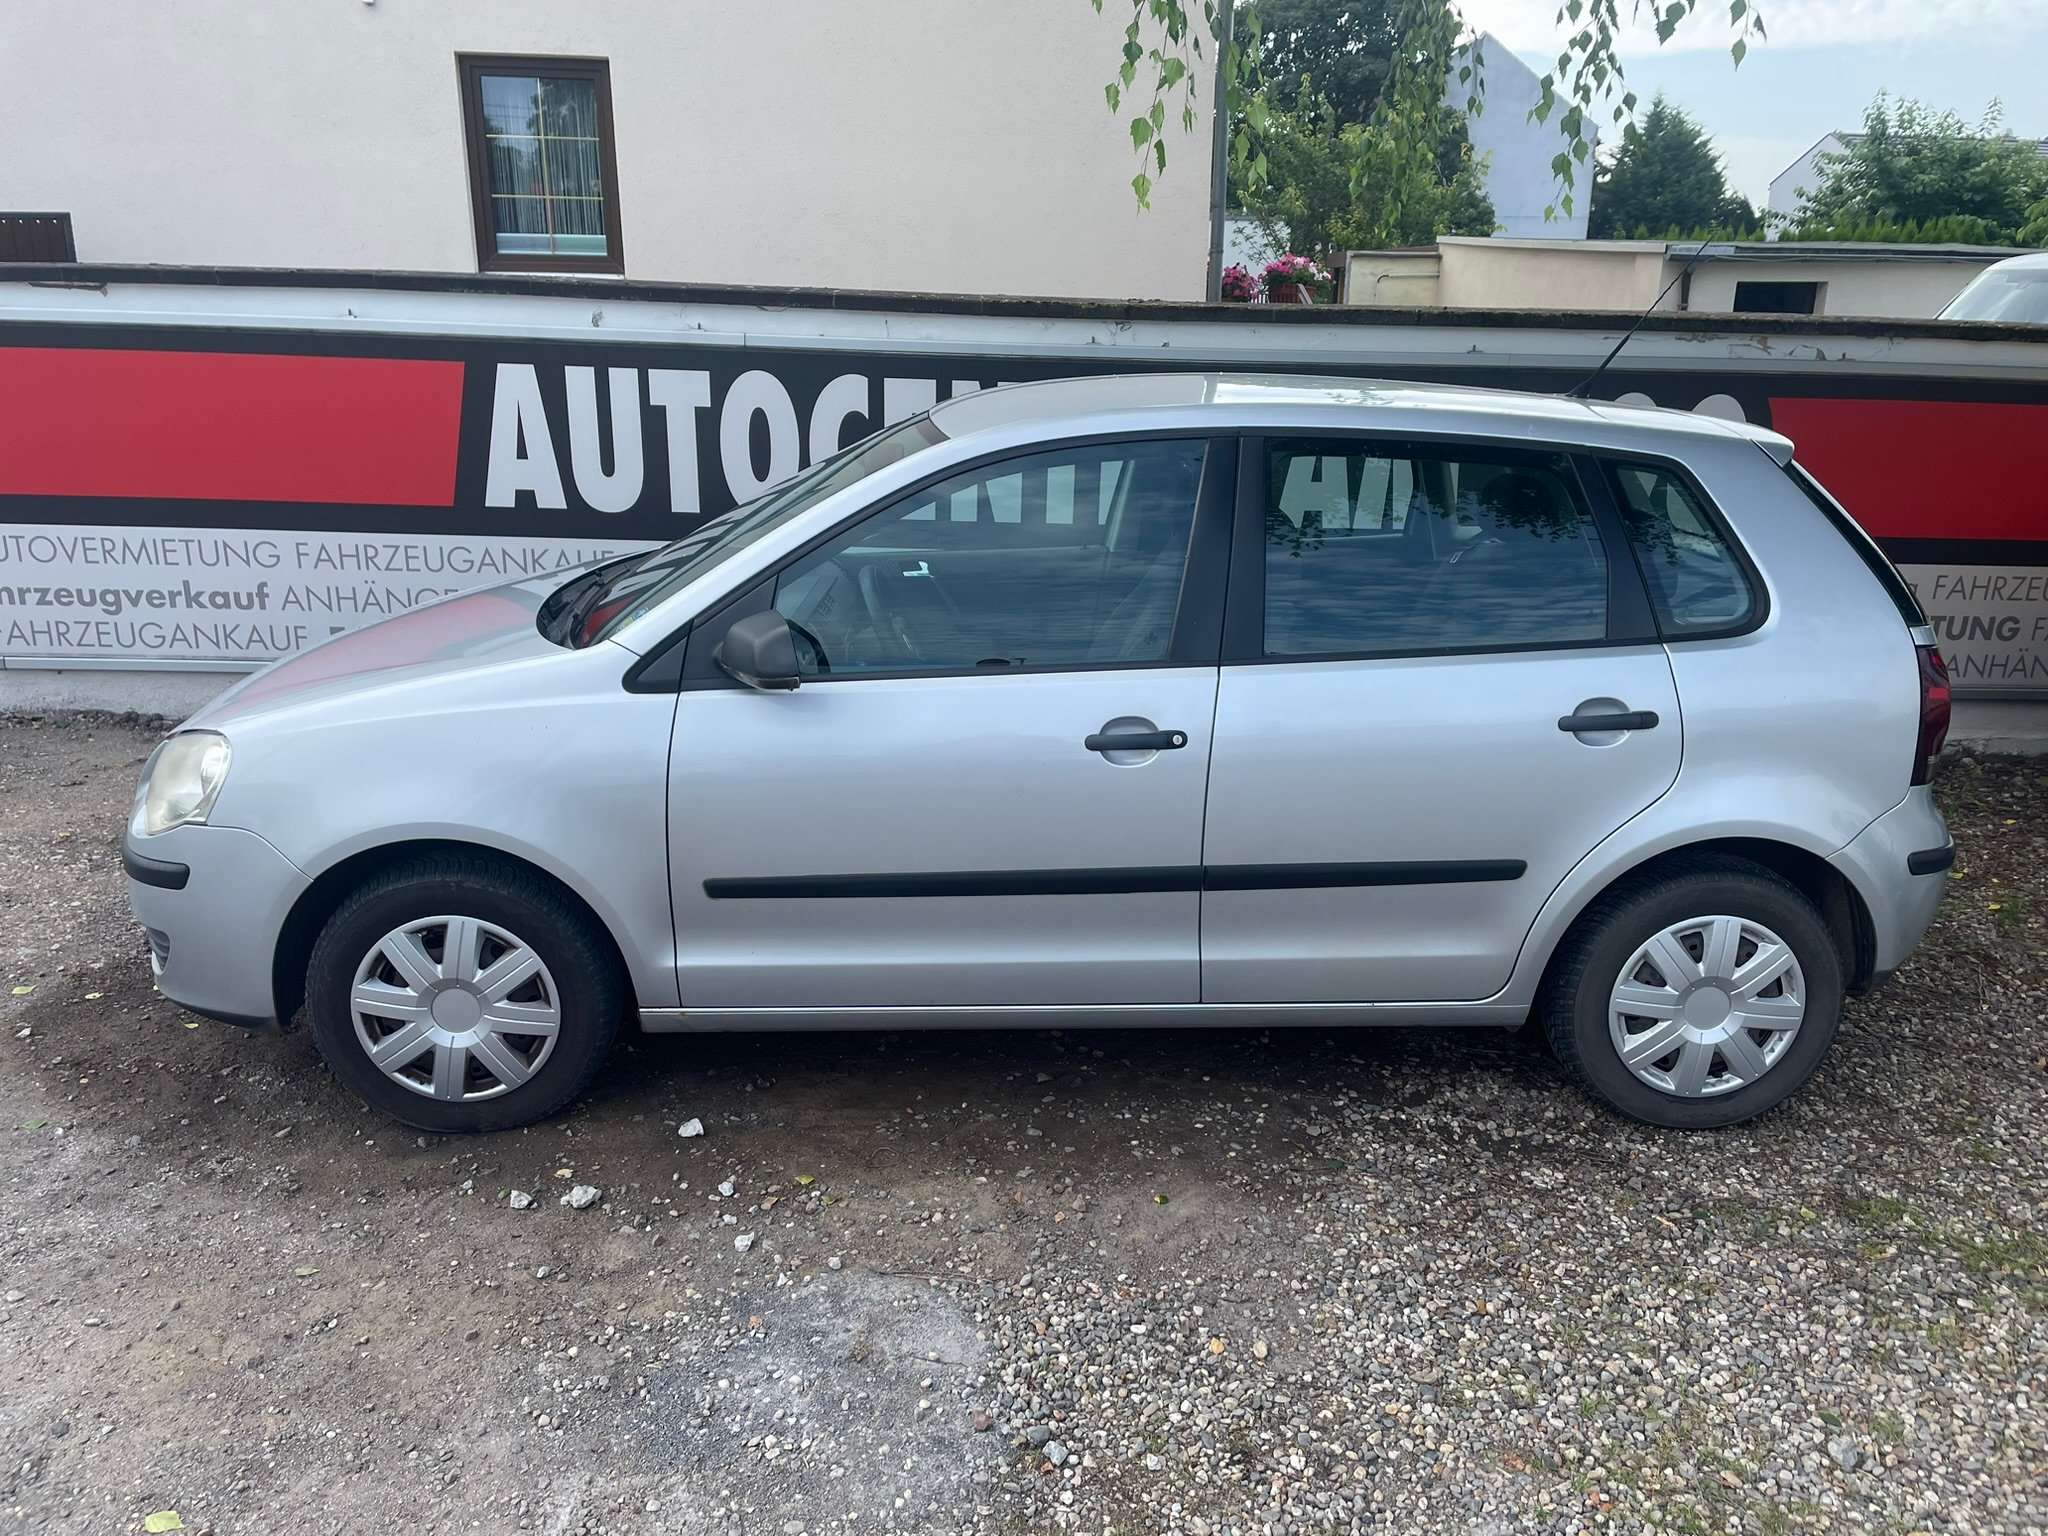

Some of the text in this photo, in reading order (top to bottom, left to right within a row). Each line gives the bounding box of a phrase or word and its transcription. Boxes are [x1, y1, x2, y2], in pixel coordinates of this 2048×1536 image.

[281, 581, 459, 614] ANHÄN
[1932, 574, 2048, 601] FAHRZE
[0, 620, 307, 651] AHRZEUGANKAUF
